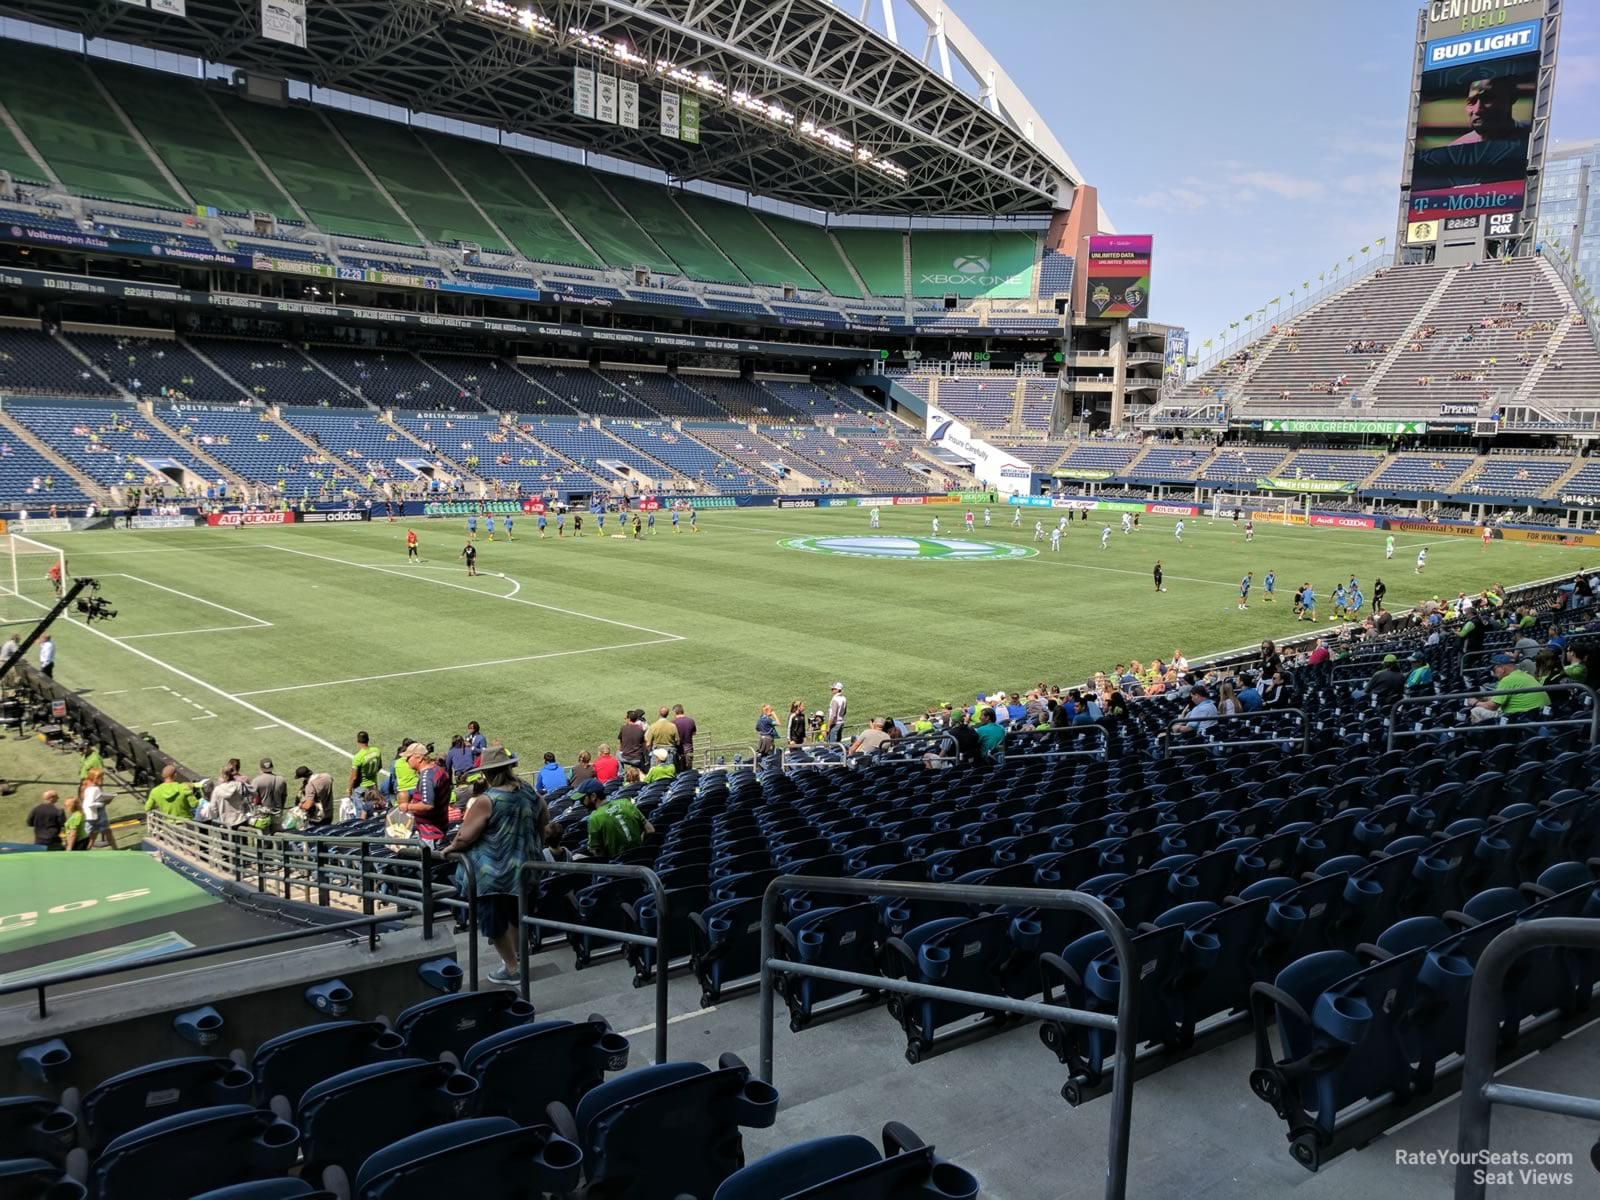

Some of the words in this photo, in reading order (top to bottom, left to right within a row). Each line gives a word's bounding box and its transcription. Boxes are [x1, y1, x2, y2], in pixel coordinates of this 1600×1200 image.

[1461, 10, 1506, 31] FIELD
[1432, 42, 1472, 61] BUD
[1473, 30, 1531, 52] LIGHT
[1490, 213, 1514, 225] Q13
[1490, 224, 1511, 235] FOX
[26, 229, 84, 244] Volkswagen
[85, 238, 108, 247] Atlas
[164, 248, 213, 261] Volkswagen
[215, 254, 235, 263] Atlas
[277, 261, 311, 274] SOUNDERS
[312, 265, 321, 275] FC
[341, 268, 361, 280] 22:29
[43, 279, 55, 288] 10
[920, 274, 977, 285] XBOX
[979, 275, 1023, 286] ONE
[124, 287, 136, 295] 22
[923, 327, 954, 335] Volkswagen
[952, 352, 972, 360] WIN
[974, 352, 990, 361] BIG
[1293, 422, 1320, 432] XBOX
[1321, 422, 1356, 432] GREEN
[1360, 423, 1393, 432] ZONE
[948, 434, 965, 448] Insure
[965, 442, 989, 461] Carefully
[327, 512, 361, 521] adidas
[1400, 522, 1447, 532] Continental
[1527, 532, 1539, 540] FOR
[1048, 1031, 1054, 1042] U
[1262, 1078, 1270, 1092] V
